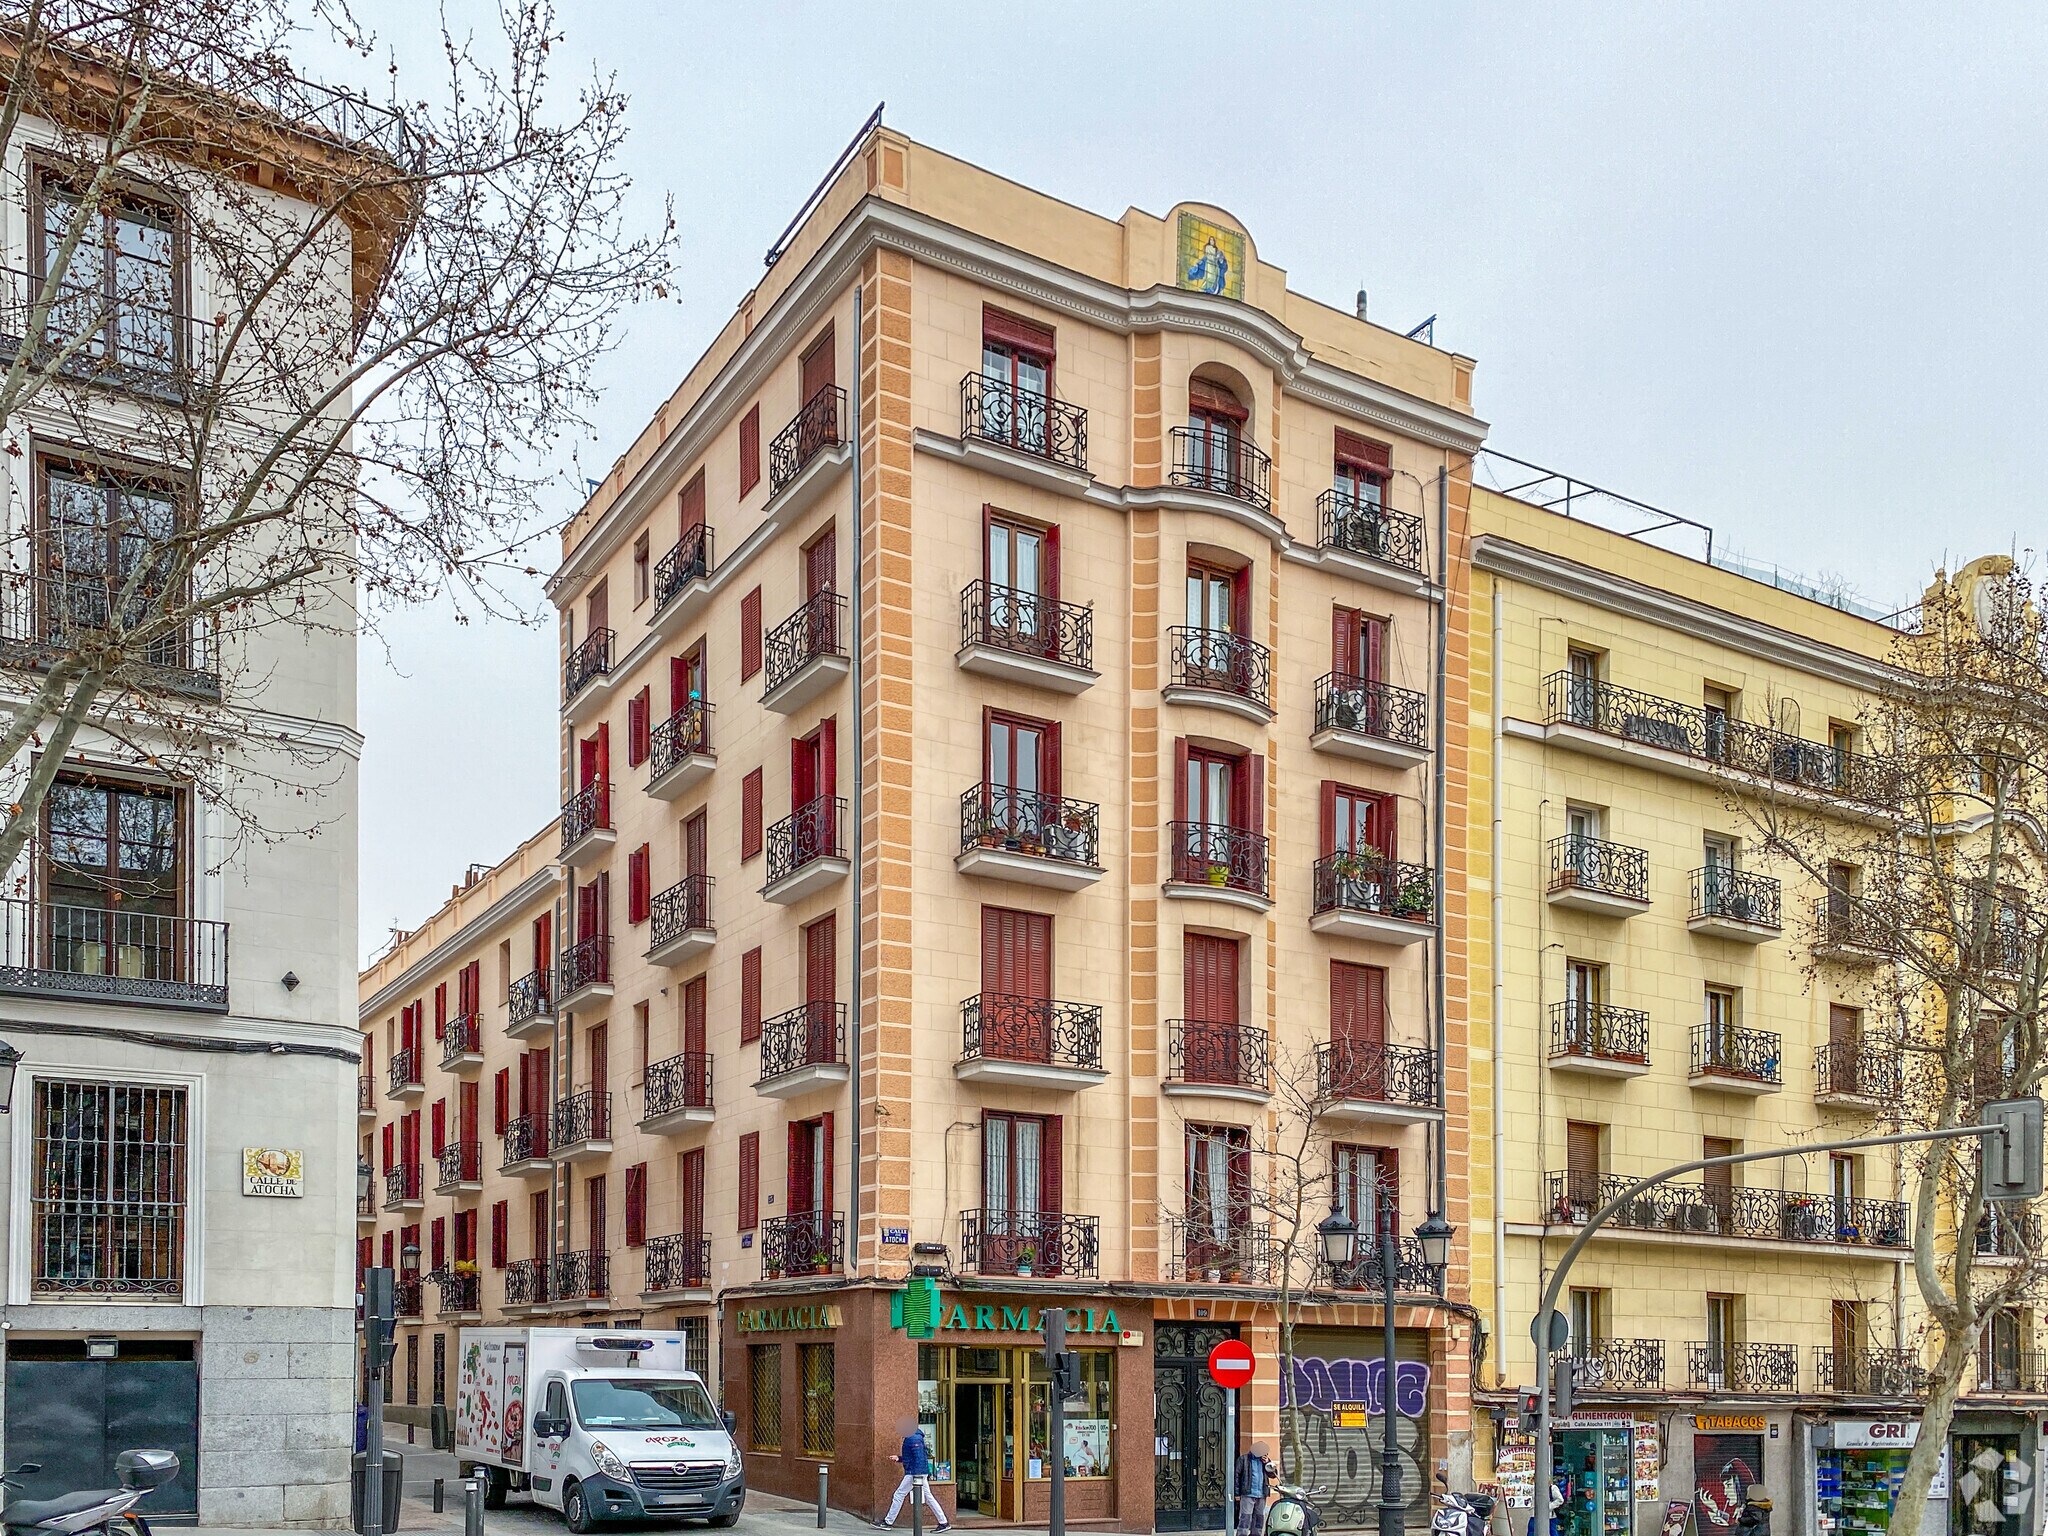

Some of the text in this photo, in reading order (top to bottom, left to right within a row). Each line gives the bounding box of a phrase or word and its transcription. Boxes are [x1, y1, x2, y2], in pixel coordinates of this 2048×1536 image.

[250, 1177, 284, 1185] CALLE
[251, 1185, 296, 1195] ATOCHA
[737, 1304, 840, 1332] FARMACIA
[939, 1304, 1122, 1333] ARMCIA
[1333, 1403, 1365, 1411] SE ALQUILA
[1709, 1416, 1767, 1428] TABACOS
[1869, 1423, 1906, 1438] GRI
